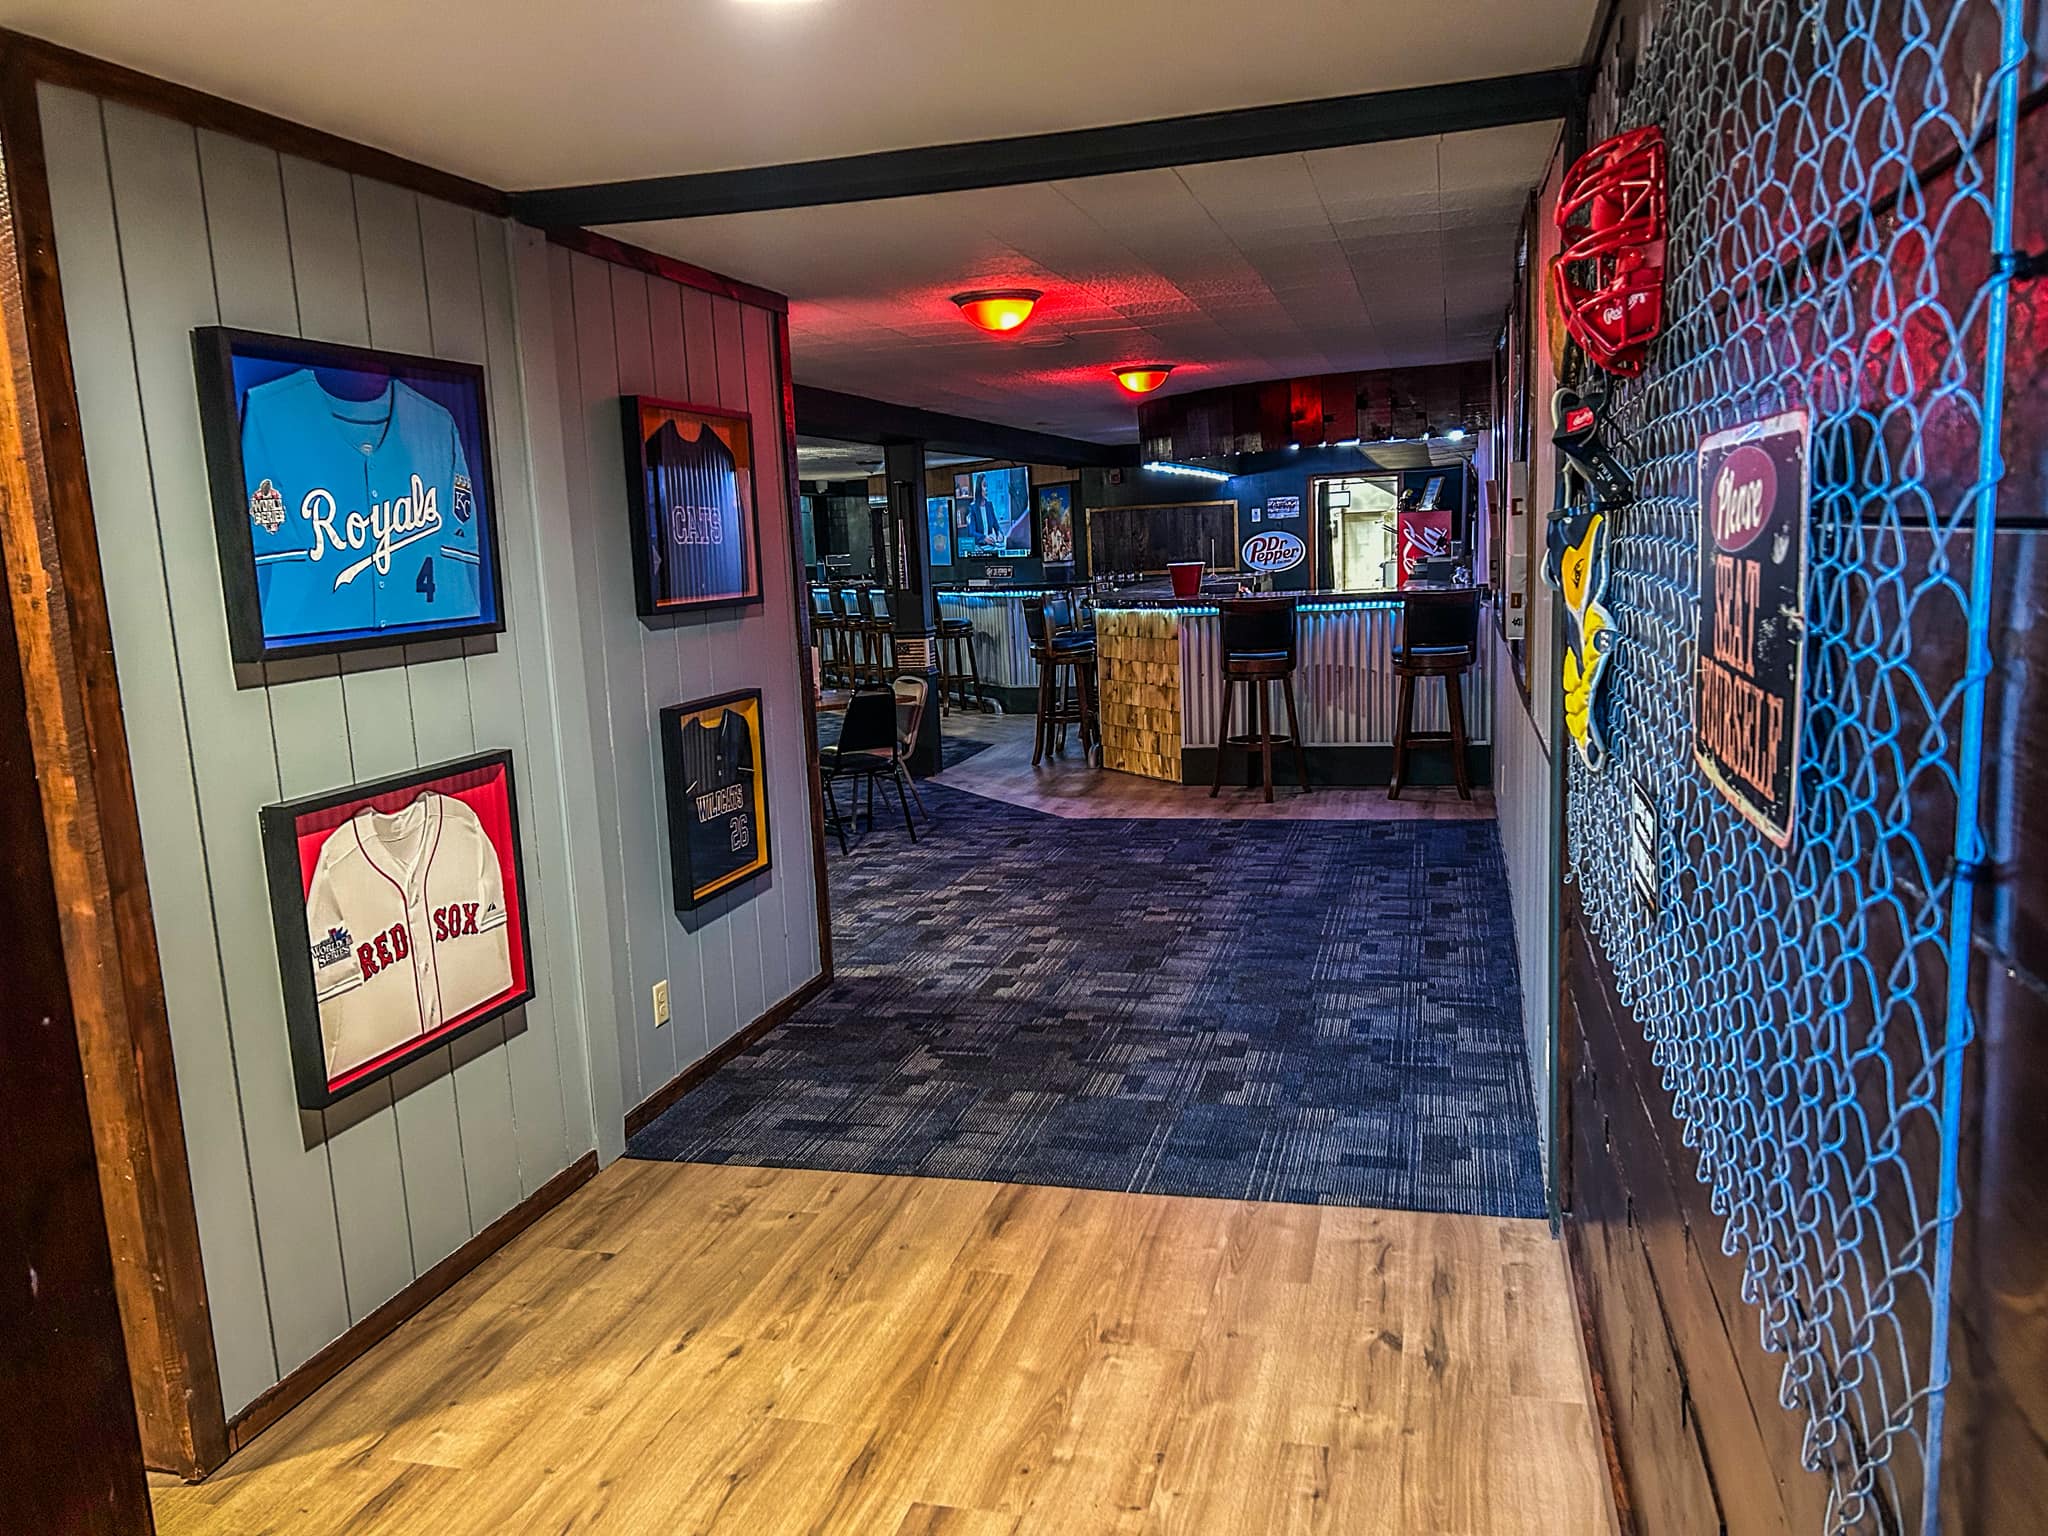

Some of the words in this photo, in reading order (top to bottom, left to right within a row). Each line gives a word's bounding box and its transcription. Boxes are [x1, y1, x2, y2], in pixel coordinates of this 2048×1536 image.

[301, 472, 442, 578] Royals
[672, 505, 723, 545] CATS
[1717, 466, 1763, 541] Please
[1249, 537, 1299, 565] Pepper
[1267, 536, 1288, 551] Dr
[416, 557, 436, 603] 4
[1714, 553, 1761, 678] SEAT
[1701, 655, 1784, 802] YOURSELF
[696, 783, 744, 823] WILDCATS
[730, 813, 750, 852] 26
[311, 940, 343, 957] WORLD
[356, 923, 409, 981] RED
[433, 902, 480, 942] SOX
